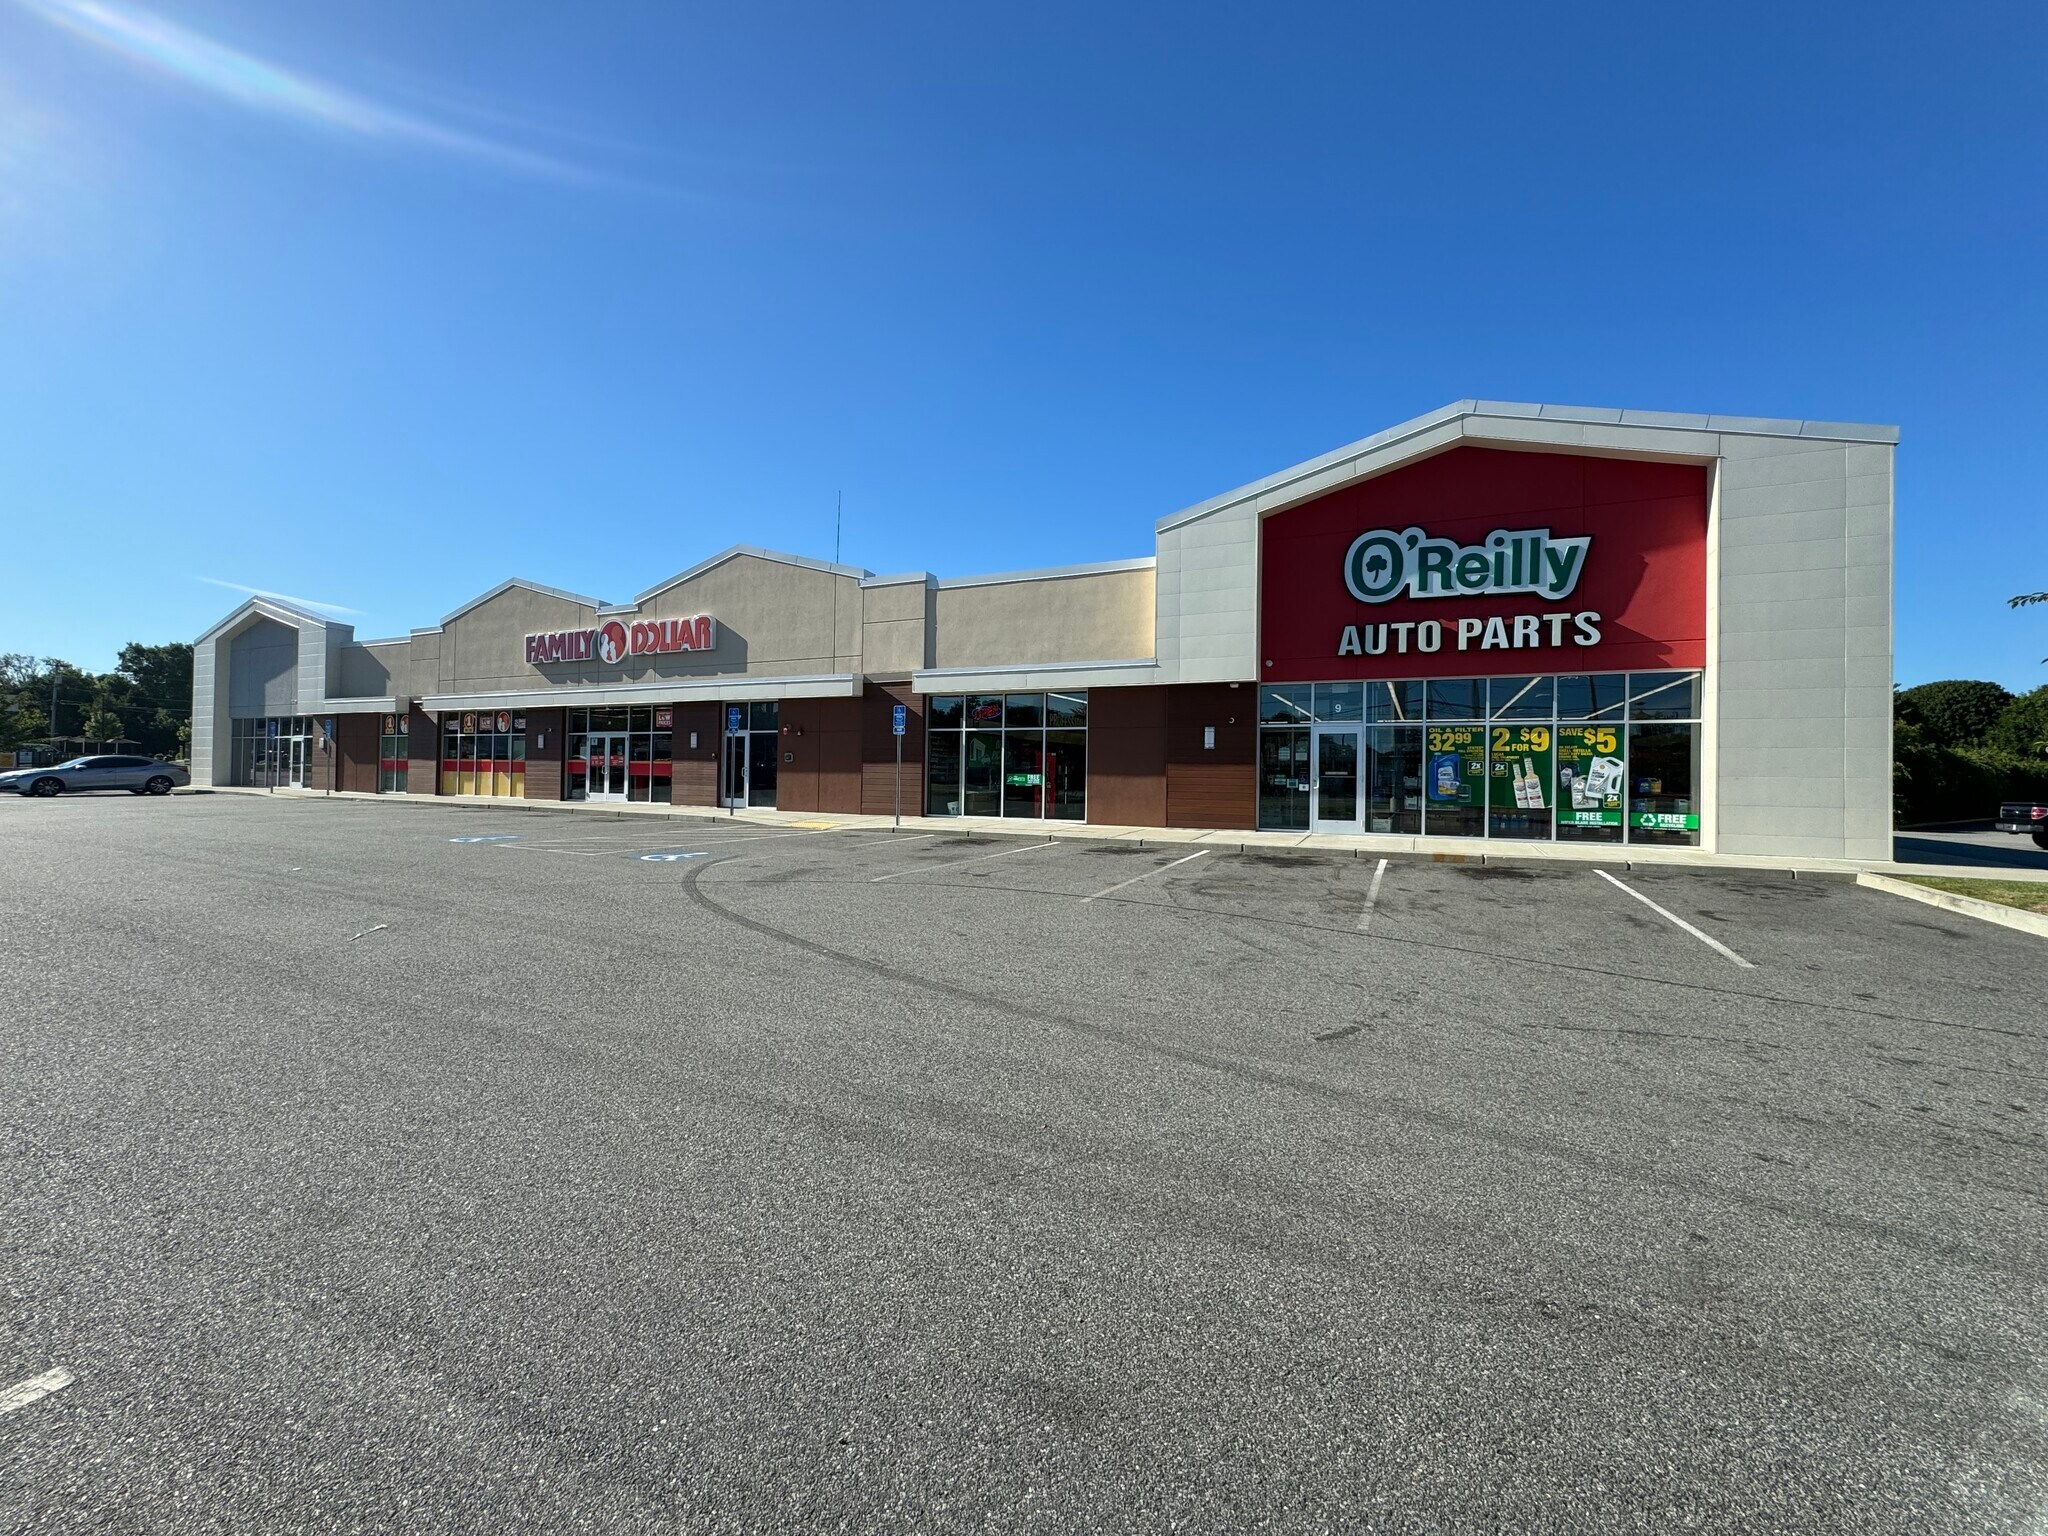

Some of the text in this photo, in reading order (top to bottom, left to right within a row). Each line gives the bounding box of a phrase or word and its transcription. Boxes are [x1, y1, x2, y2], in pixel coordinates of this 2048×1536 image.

[1350, 533, 1581, 597] O'Reilly
[525, 614, 713, 663] FAMILY DOLLAR
[1337, 611, 1602, 657] AUTO PARTS
[1334, 703, 1342, 713] 9
[1491, 727, 1550, 752] 2 FOR $9
[1559, 727, 1617, 753] SAVE $5
[1575, 811, 1603, 821] FREE
[1657, 813, 1687, 824] FREE
